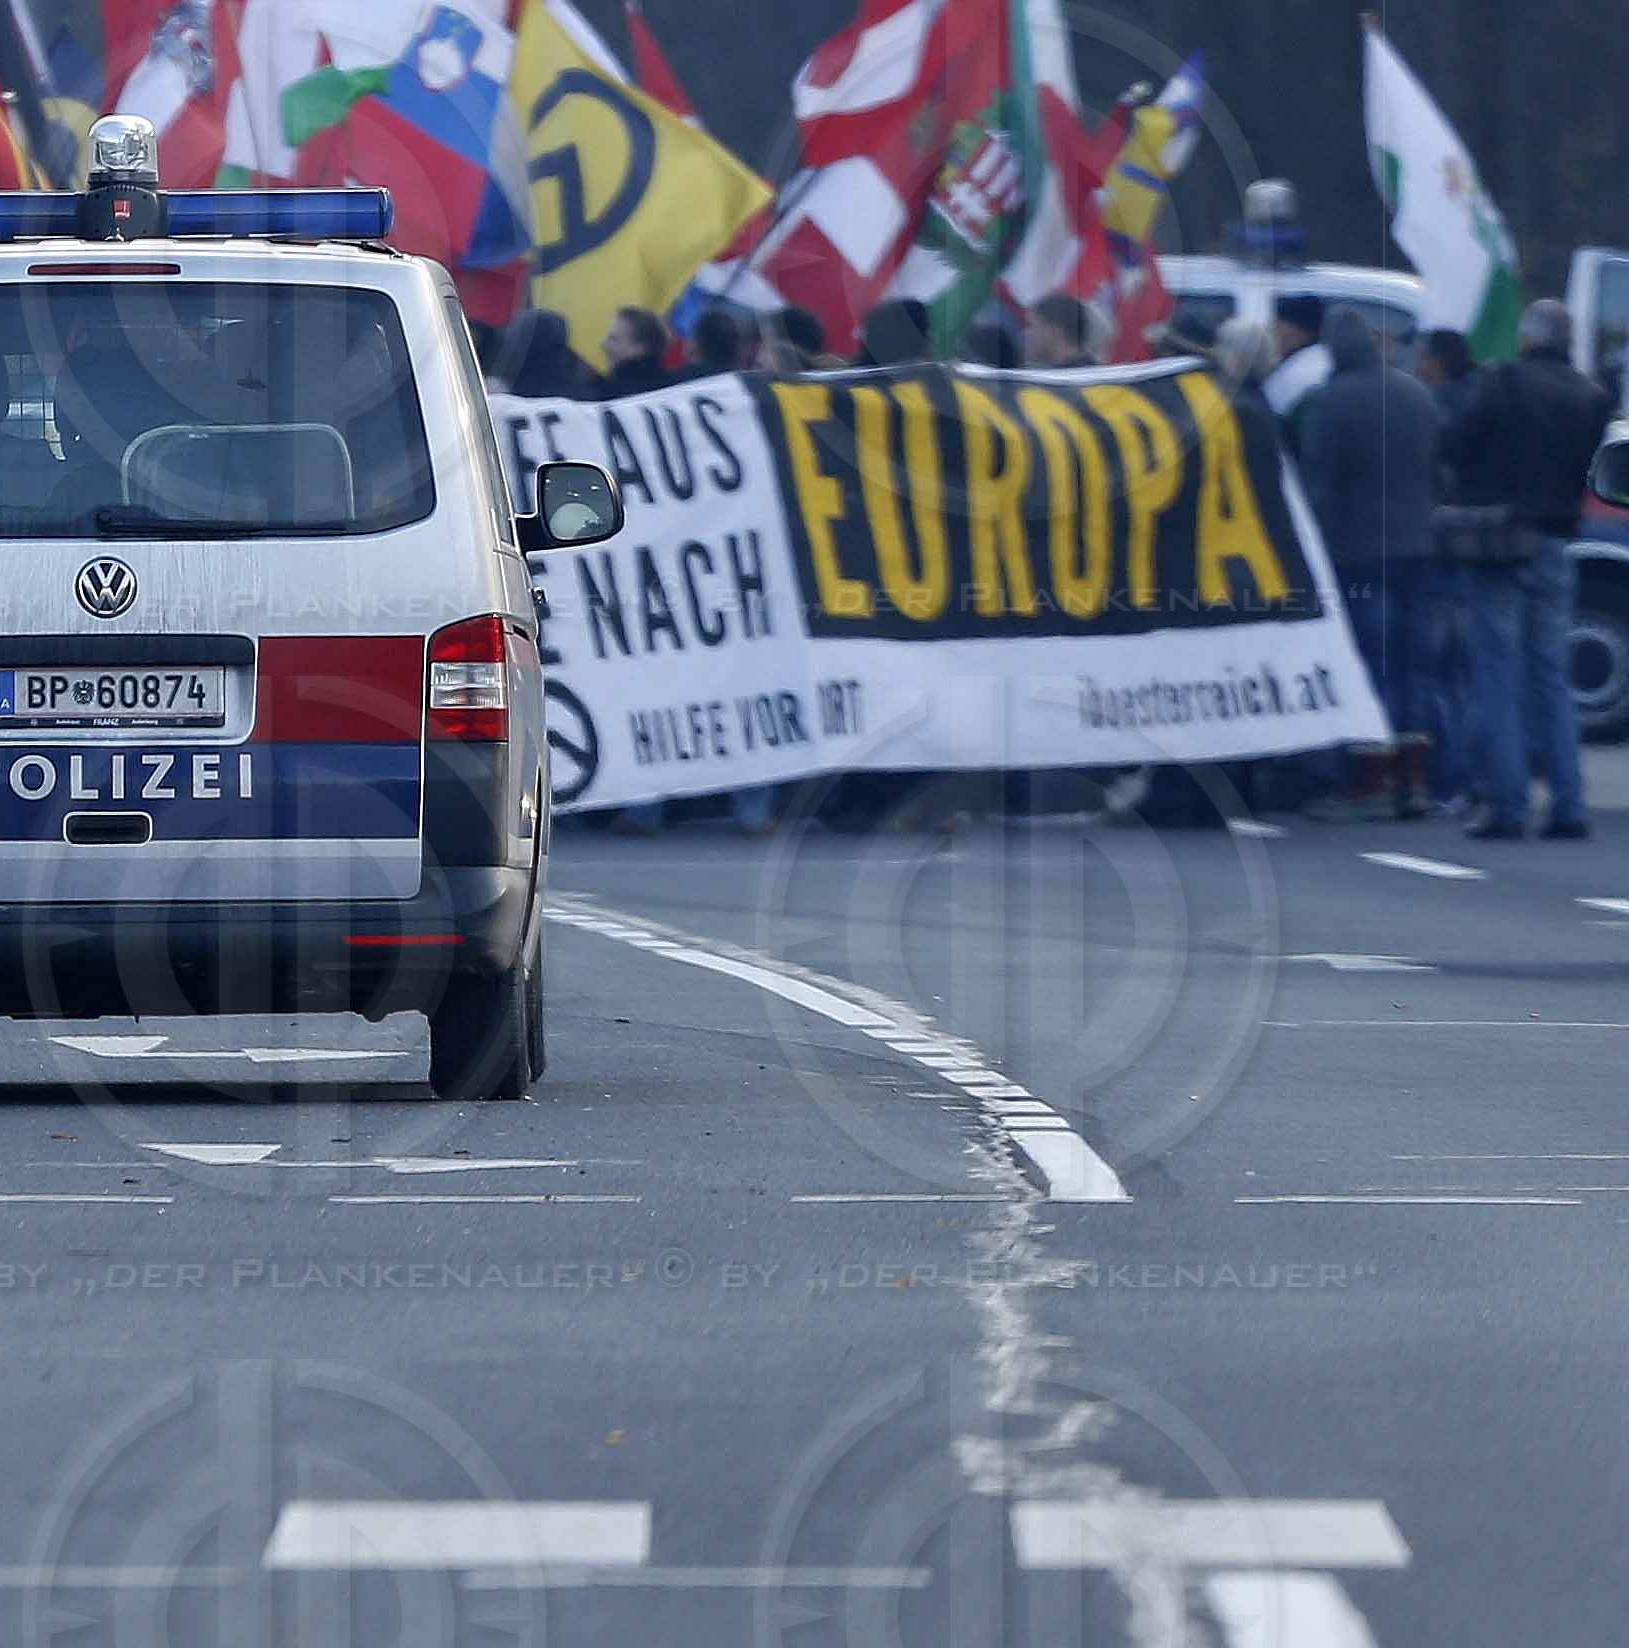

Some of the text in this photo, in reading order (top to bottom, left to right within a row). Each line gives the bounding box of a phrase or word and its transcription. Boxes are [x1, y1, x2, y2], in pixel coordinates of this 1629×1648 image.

[599, 396, 742, 504] AUS
[771, 371, 1290, 622] EUROPA
[574, 529, 772, 659] NACH
[27, 674, 206, 710] BP 60874
[627, 698, 728, 765] HILFE
